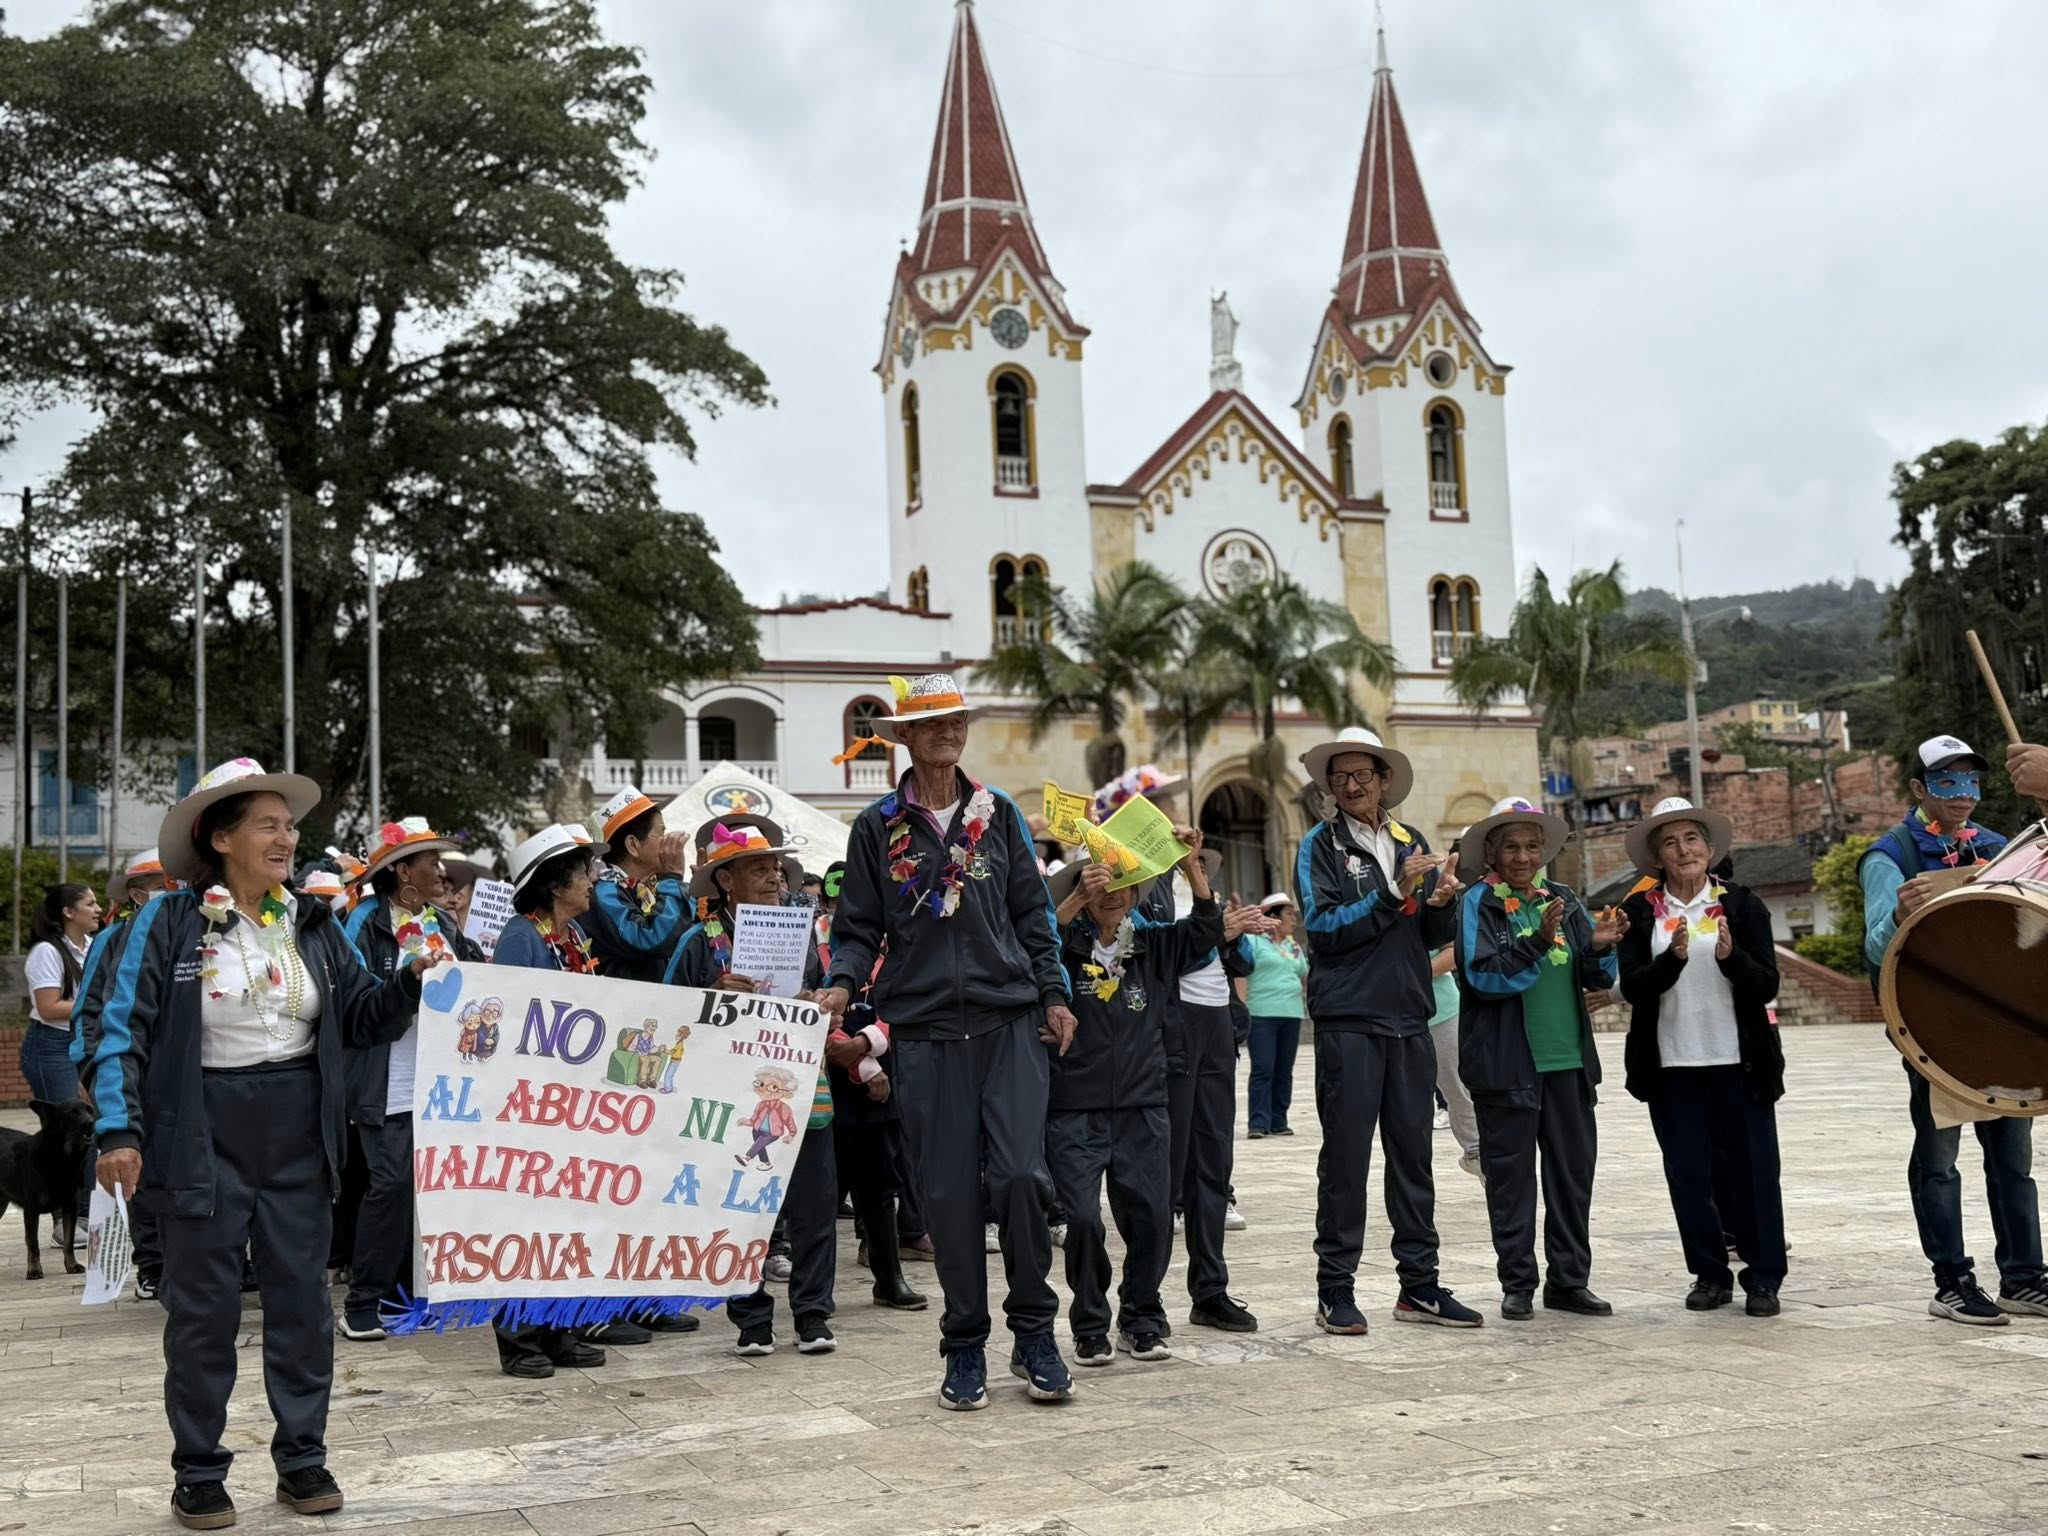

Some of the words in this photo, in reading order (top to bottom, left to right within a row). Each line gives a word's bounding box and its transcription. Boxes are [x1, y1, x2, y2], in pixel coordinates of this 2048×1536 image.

[475, 890, 496, 900] MAYOR
[742, 920, 776, 928] ADULTO
[738, 938, 763, 946] PUEDE
[694, 991, 739, 1027] 15
[741, 999, 819, 1026] JUNIO
[514, 998, 606, 1065] NO
[757, 1029, 790, 1046] DIA
[729, 1040, 817, 1065] MUNDIAL
[421, 1075, 481, 1122] AL
[496, 1079, 656, 1136] ABUSO
[679, 1097, 735, 1144] NI
[415, 1145, 643, 1206] MALTRATO
[662, 1163, 700, 1206] A
[720, 1169, 783, 1214] LA
[604, 1228, 769, 1286] MAYOR
